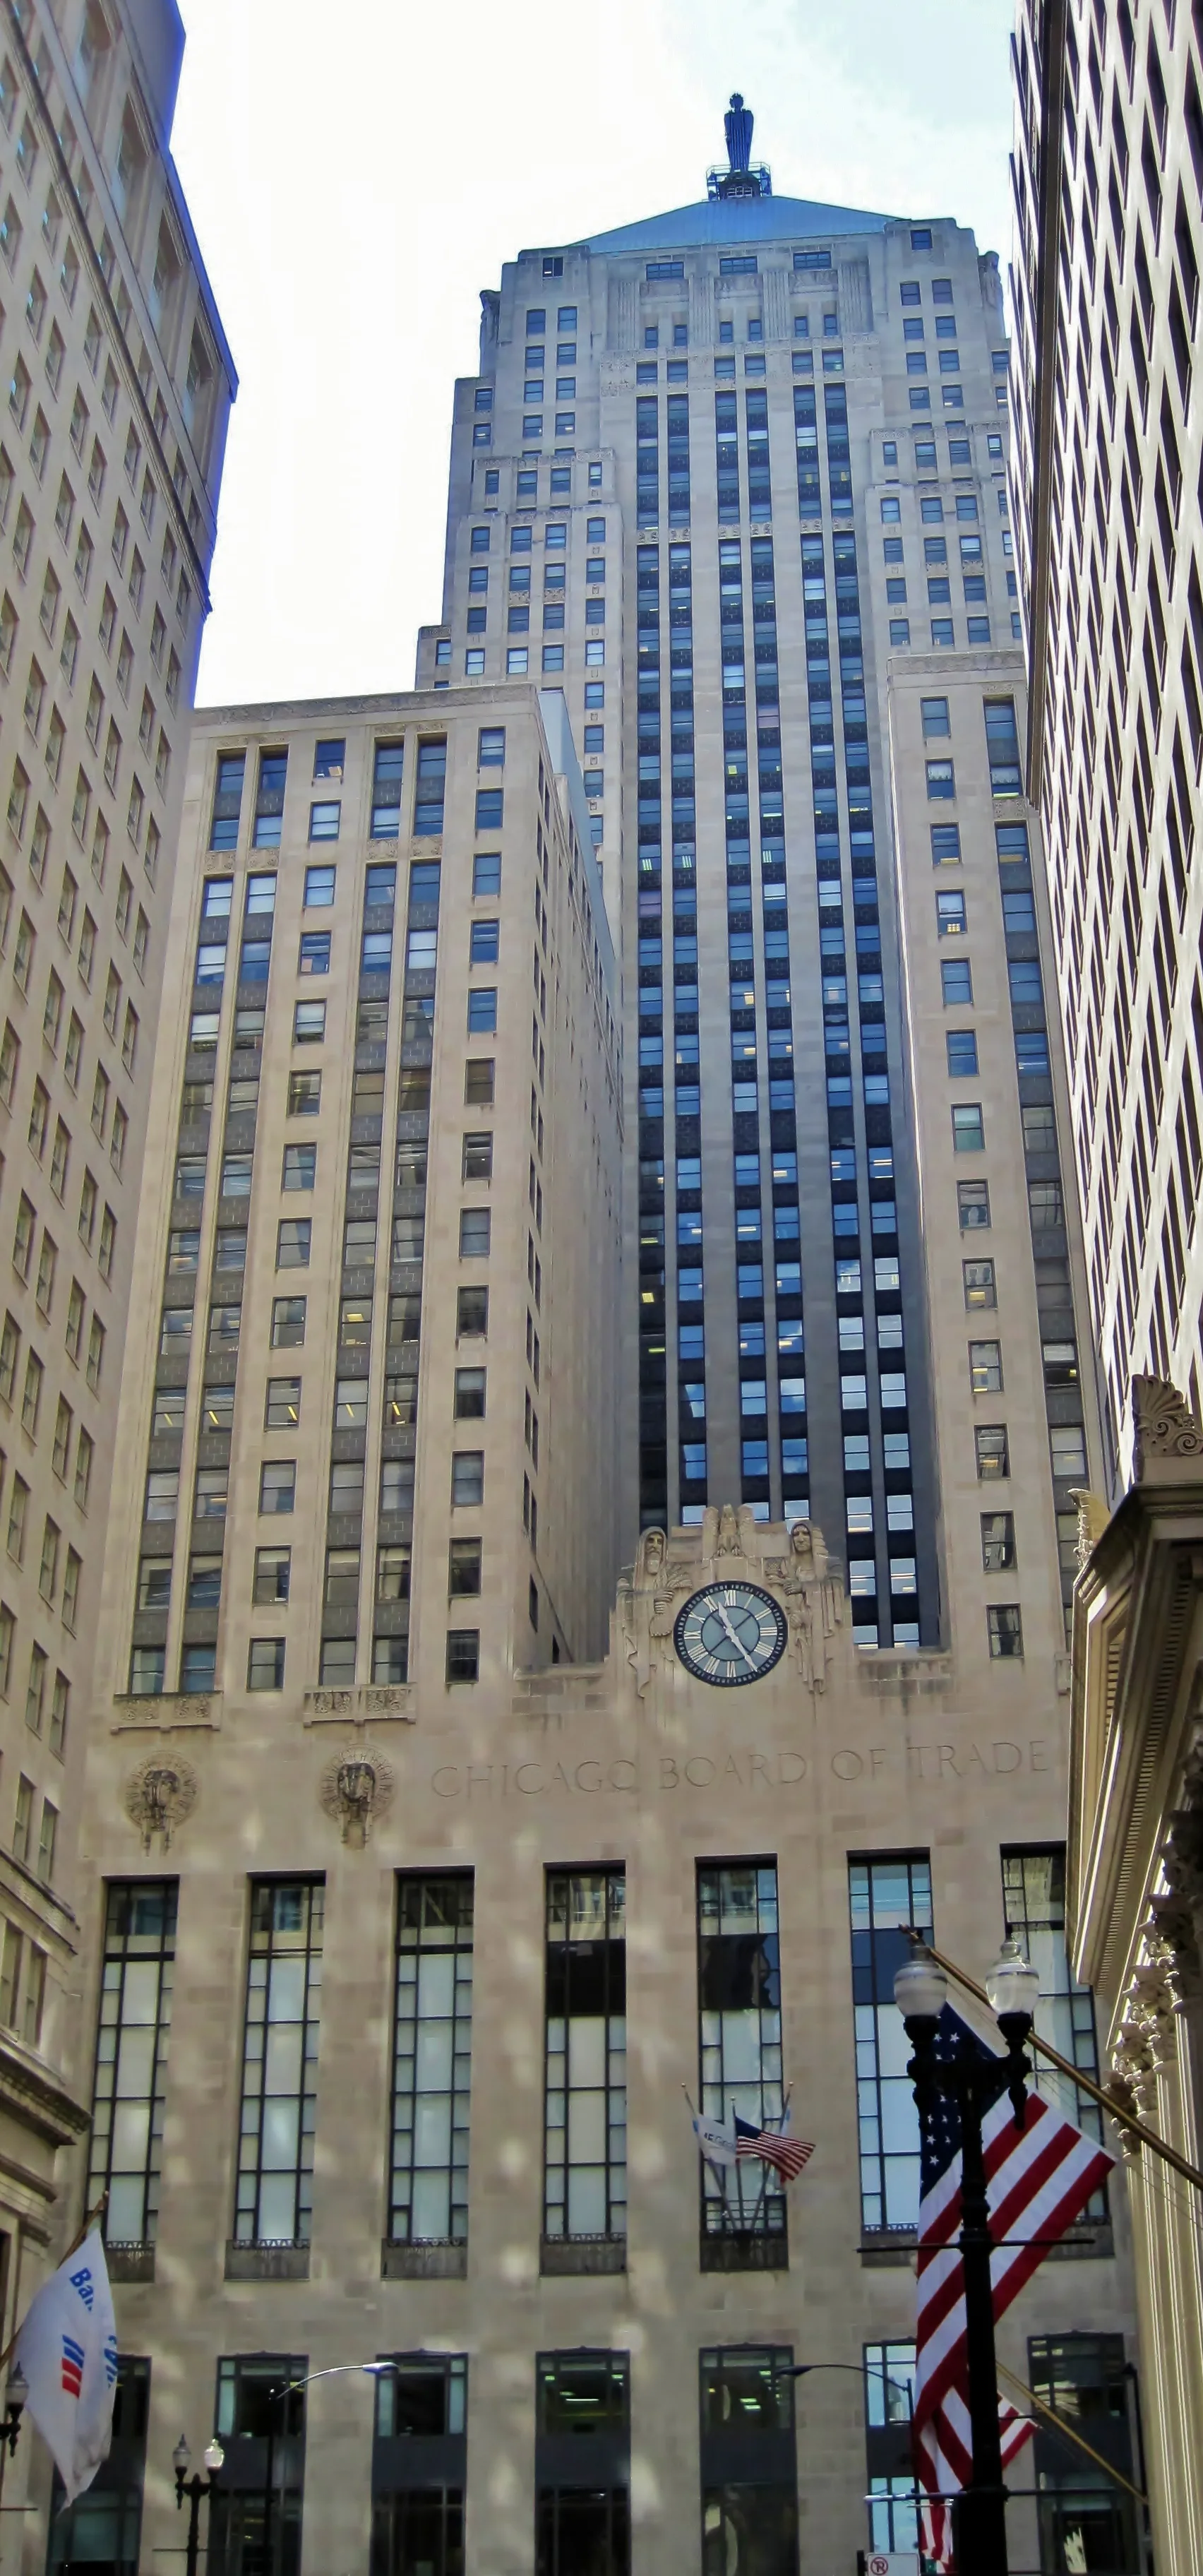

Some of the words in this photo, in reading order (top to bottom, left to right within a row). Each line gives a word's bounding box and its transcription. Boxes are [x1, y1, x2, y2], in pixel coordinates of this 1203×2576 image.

[703, 1595, 718, 1613] XI
[724, 1590, 736, 1606] XII
[688, 1611, 706, 1623] X
[755, 1608, 772, 1620] II
[760, 1627, 777, 1636] III
[431, 1759, 637, 1799] CHICAGO
[659, 1753, 808, 1791] BOARD
[831, 1748, 887, 1782] OF
[907, 1741, 1049, 1779] TRADE
